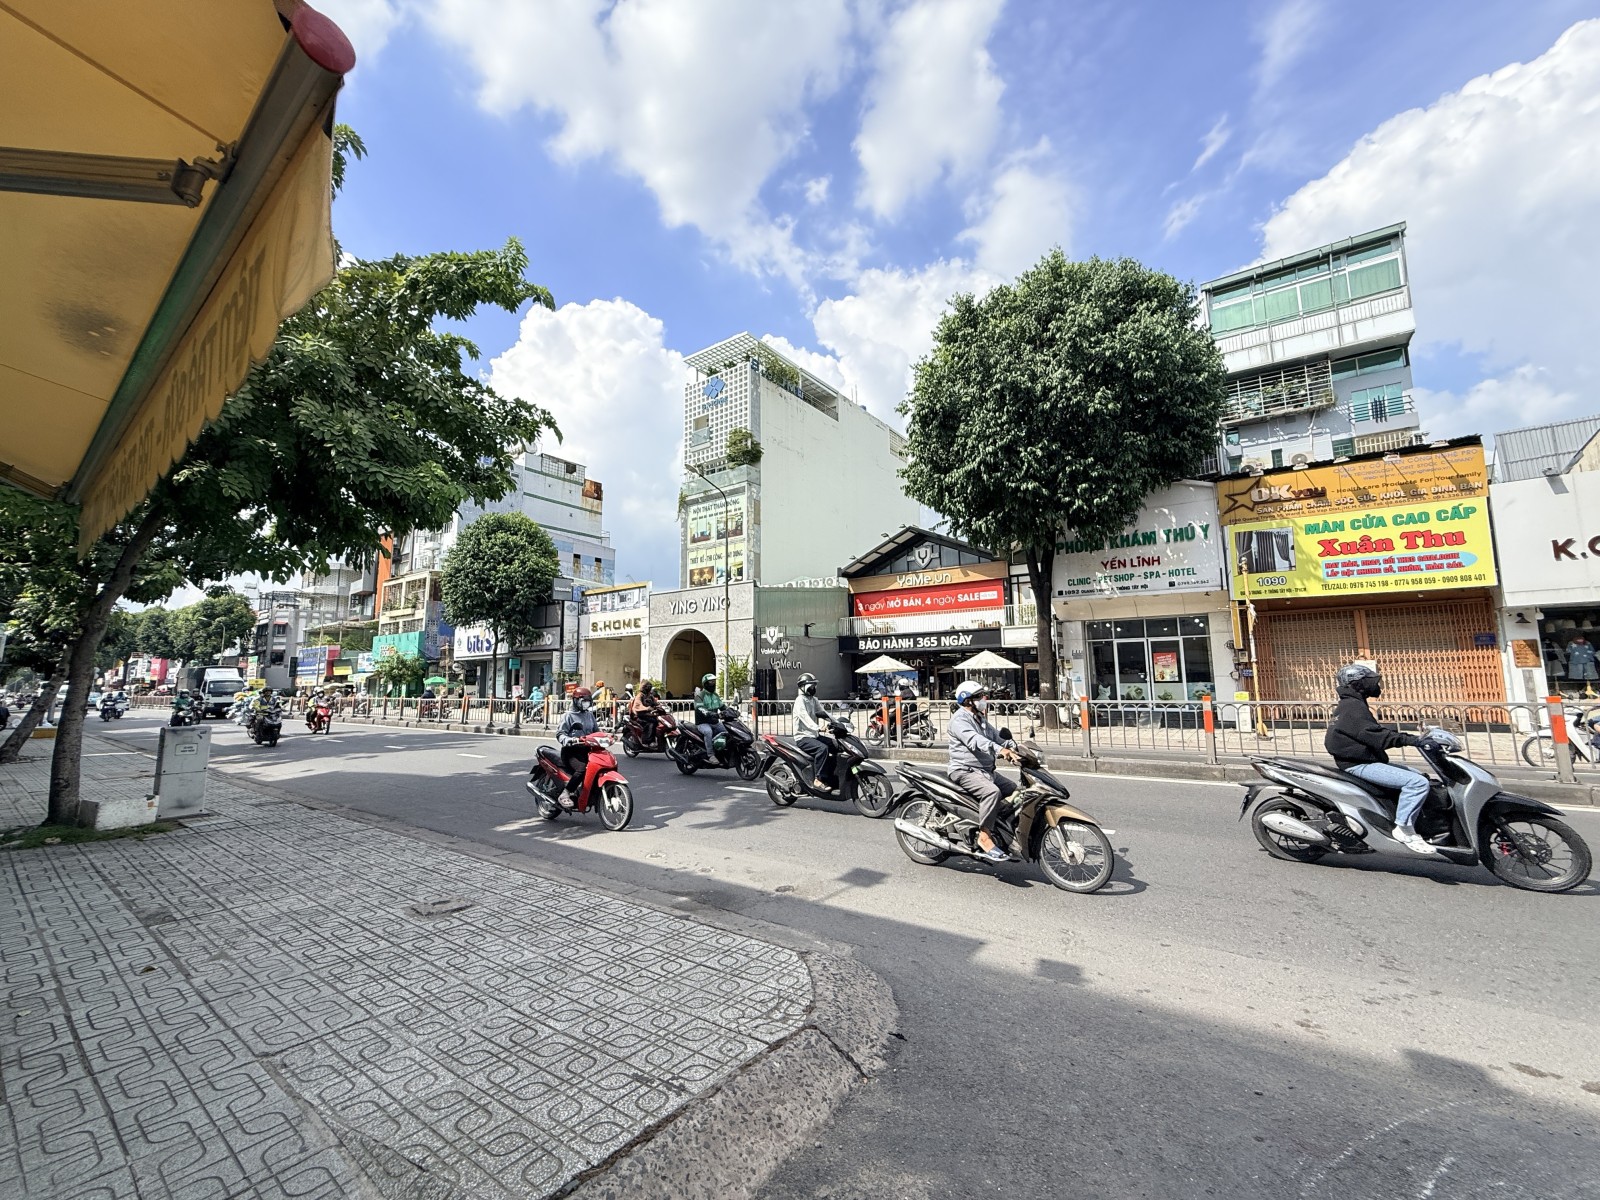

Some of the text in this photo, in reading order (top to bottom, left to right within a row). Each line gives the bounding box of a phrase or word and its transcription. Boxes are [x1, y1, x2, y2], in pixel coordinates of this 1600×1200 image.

[1304, 503, 1477, 535] MÀN CỬA CAO CẤP
[1110, 530, 1157, 550] KHÁM
[1164, 523, 1195, 544] THÚ
[1317, 529, 1467, 557] Xuân Thu
[1101, 555, 1127, 570] YẾN
[1067, 576, 1092, 587] CLINIC
[1143, 570, 1161, 580] SPA
[1168, 567, 1197, 577] HOTEL
[1256, 576, 1287, 587] 1090
[1321, 582, 1348, 590] TEL/ZALO:
[1350, 581, 1364, 589] 0976
[1395, 579, 1410, 587] 0774
[1442, 576, 1459, 584] 0909
[669, 598, 698, 616] YING
[858, 602, 864, 610] 3
[864, 602, 885, 612] ngày
[932, 596, 956, 606] ngày
[957, 592, 980, 601] SALE
[858, 632, 973, 650] BẢO HÀNH 365 NGÀY
